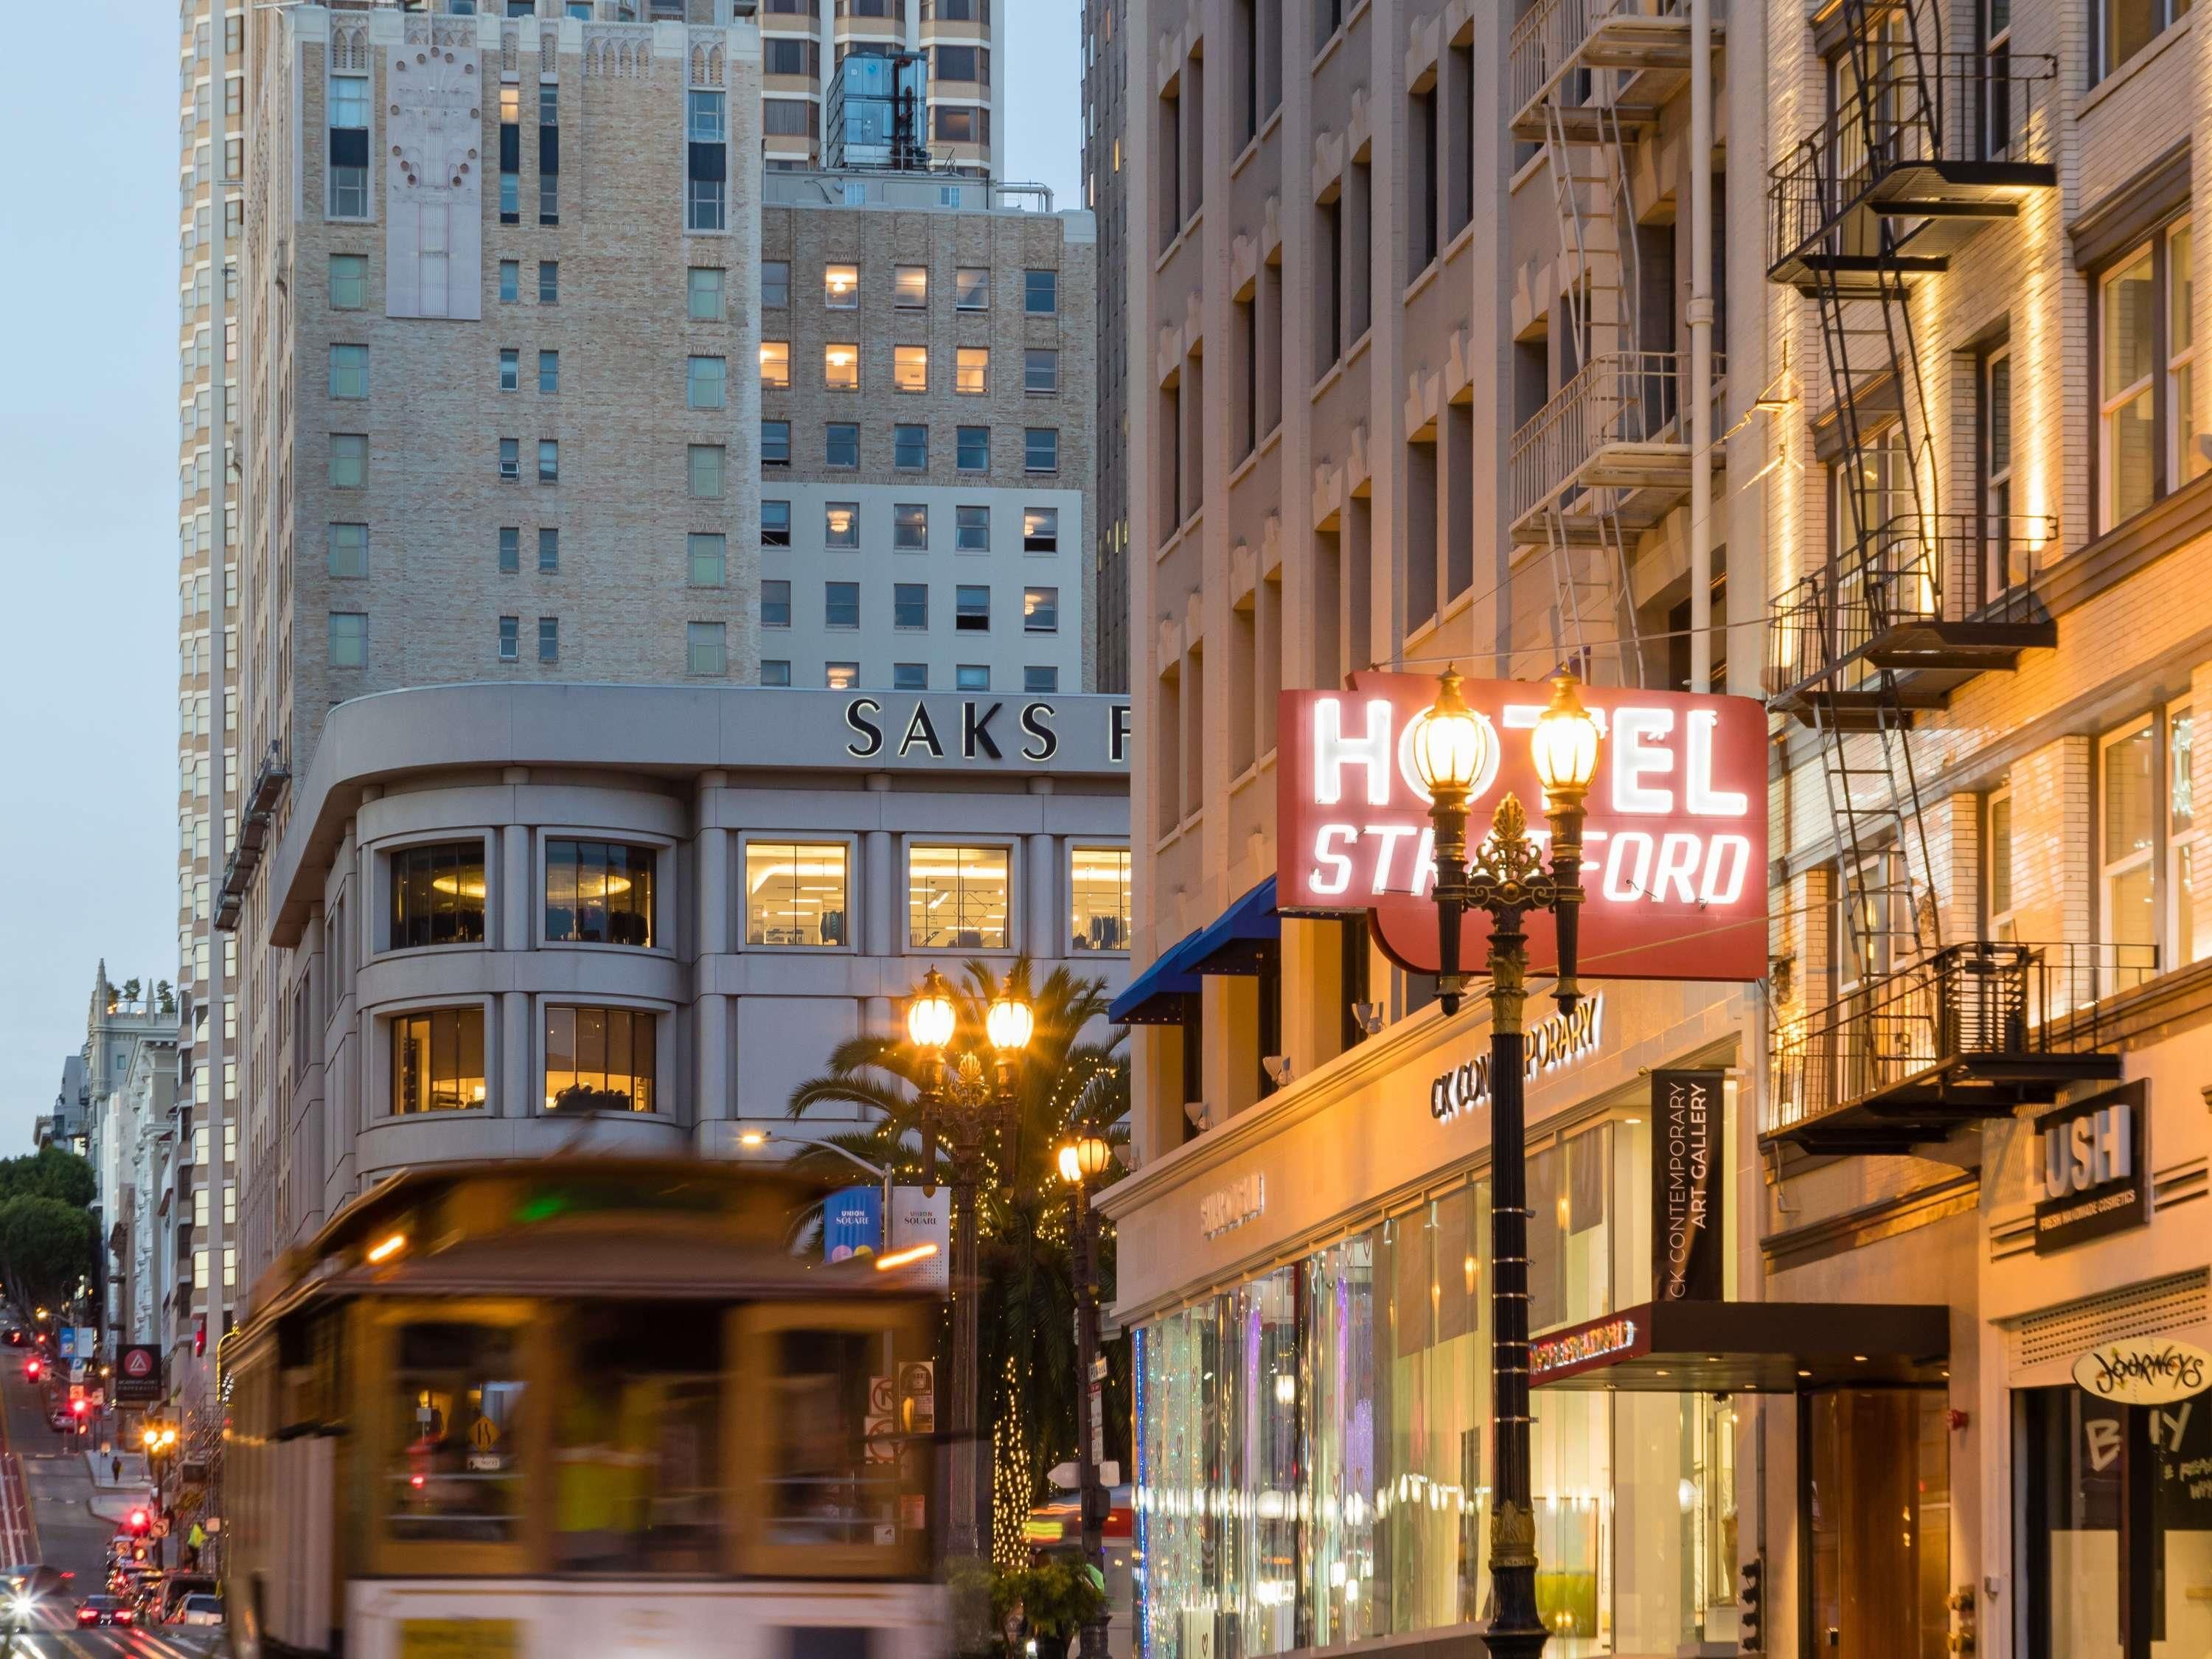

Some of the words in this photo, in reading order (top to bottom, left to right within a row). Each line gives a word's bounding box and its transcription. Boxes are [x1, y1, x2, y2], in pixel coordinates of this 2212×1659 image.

[846, 698, 1058, 761] SAKS
[1431, 1072, 1453, 1119] CK
[1457, 998, 1597, 1107] CONPORARY
[1690, 1082, 1708, 1180] GALLERY
[1669, 1082, 1686, 1264] CONTEMPORARY
[835, 1217, 870, 1225] SQUARE
[904, 1217, 938, 1225] SQUARE
[1691, 1186, 1708, 1229] ART
[1669, 1269, 1686, 1298] CK
[2093, 1345, 2205, 1394] JOURNEYS
